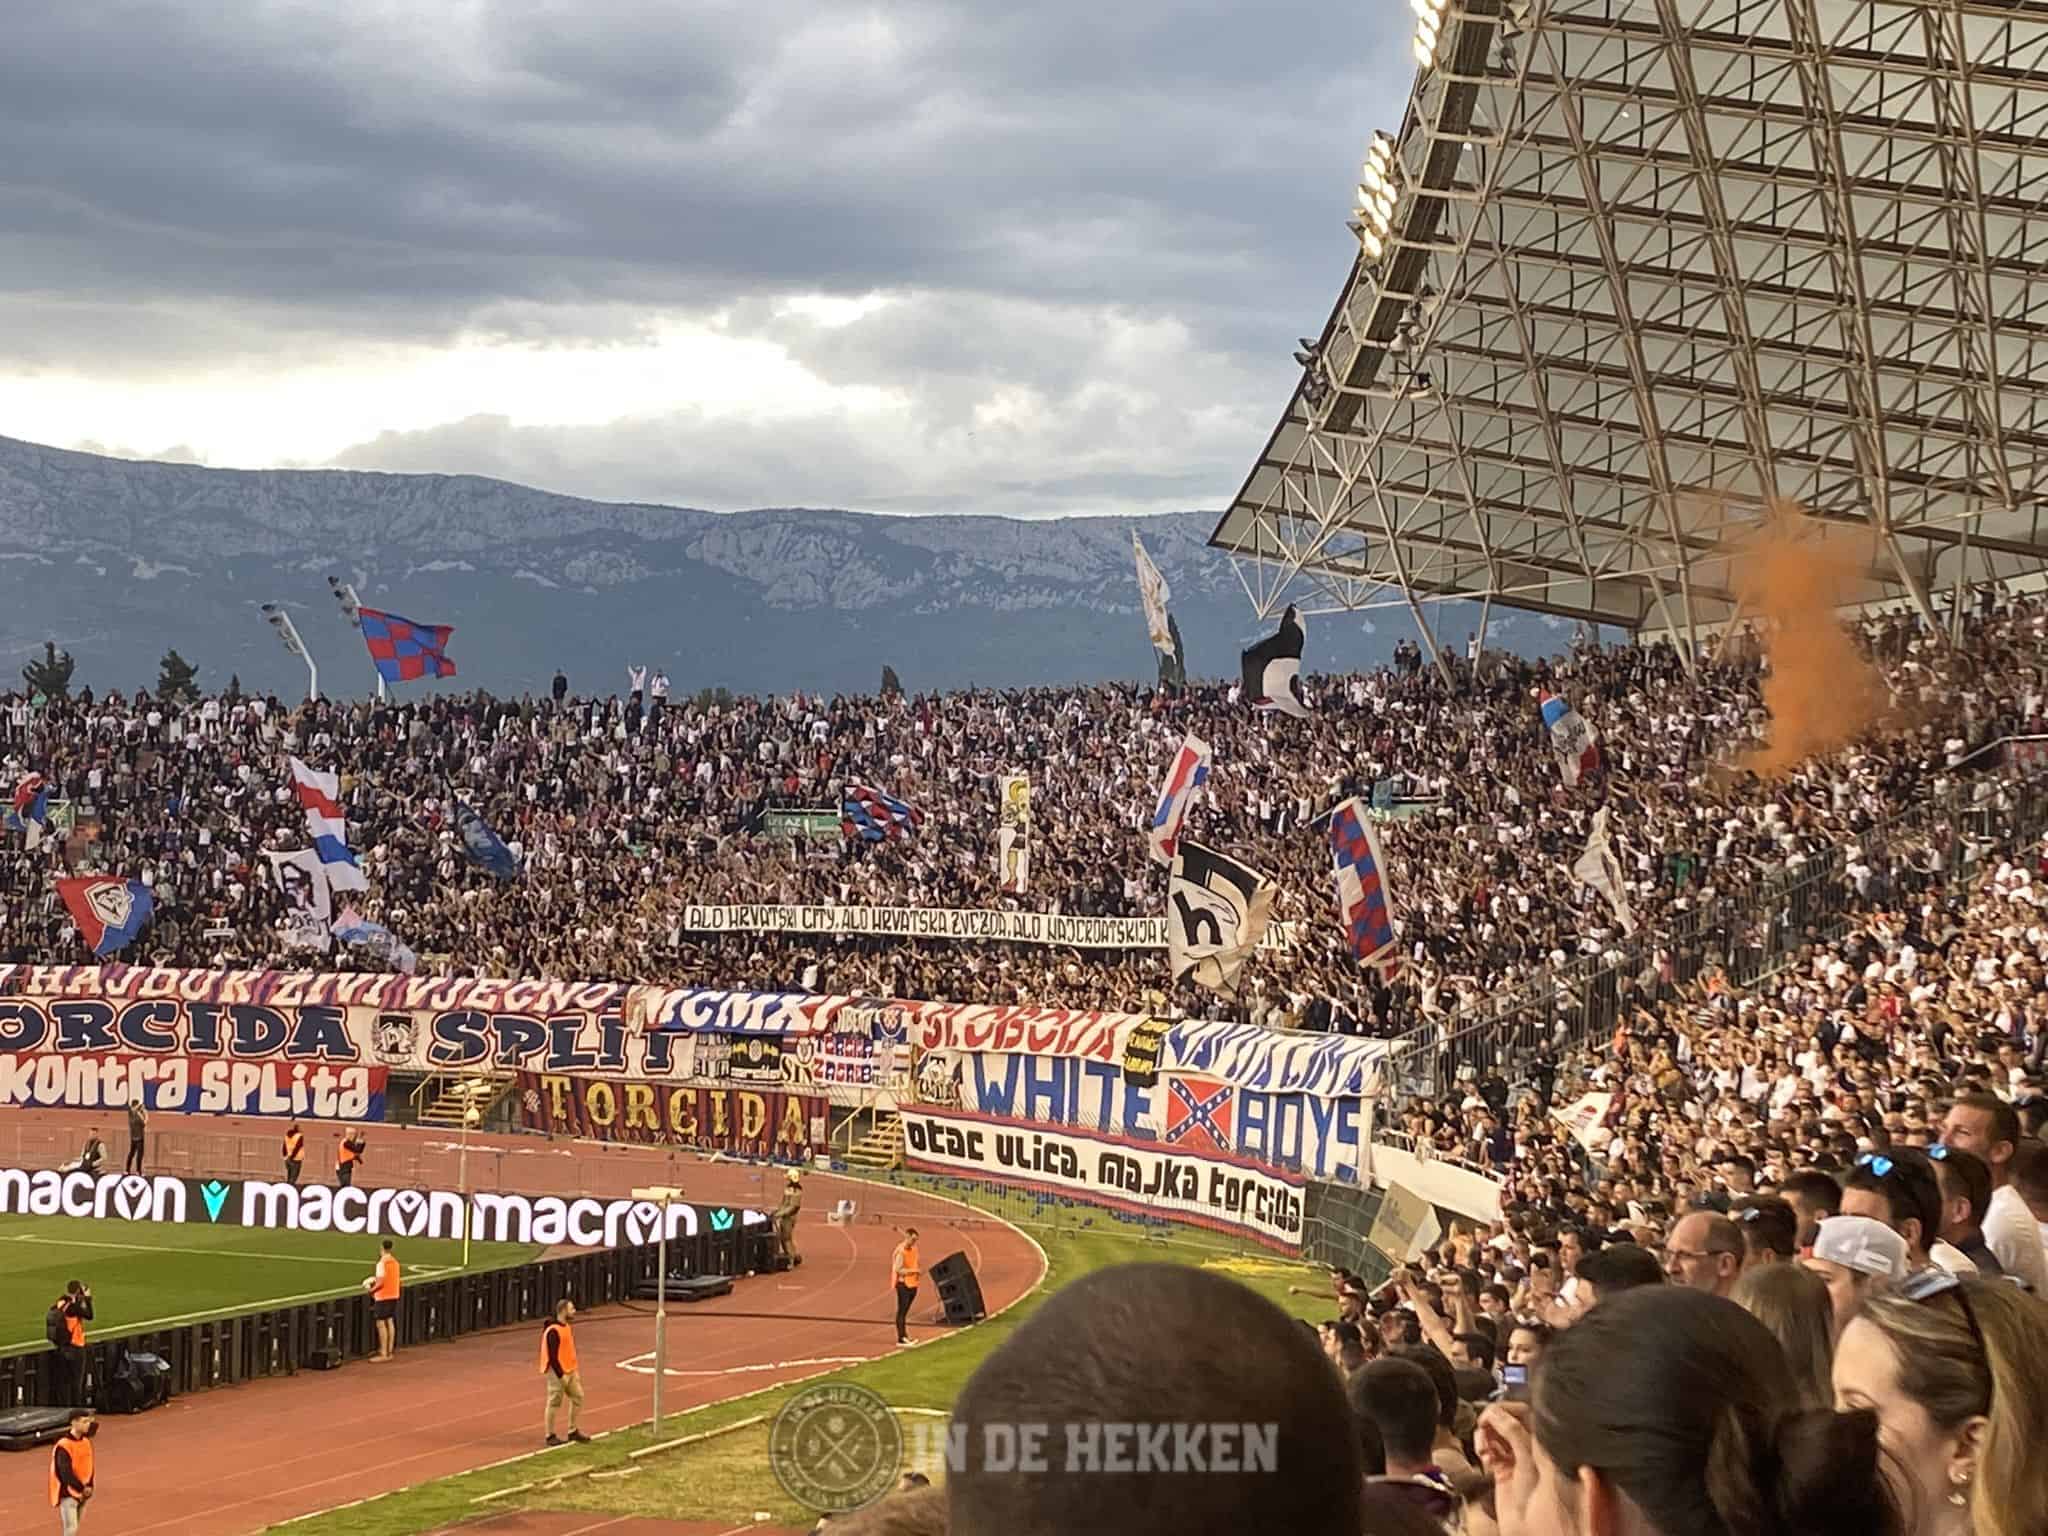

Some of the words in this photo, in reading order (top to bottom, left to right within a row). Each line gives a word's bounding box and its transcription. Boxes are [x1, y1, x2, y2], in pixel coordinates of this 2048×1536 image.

[690, 907, 723, 928] ALO
[842, 908, 868, 930] ALO
[872, 909, 947, 933] HRVATSKA
[1015, 915, 1041, 939] ALO
[27, 964, 265, 1004] HAJDUK
[428, 1009, 690, 1074] SPLIT
[541, 1075, 808, 1145] TORCIDA
[971, 1050, 1157, 1141] WHITE
[1237, 1090, 1361, 1184] BOYS
[242, 1181, 463, 1241] macron
[472, 1191, 698, 1246] macron
